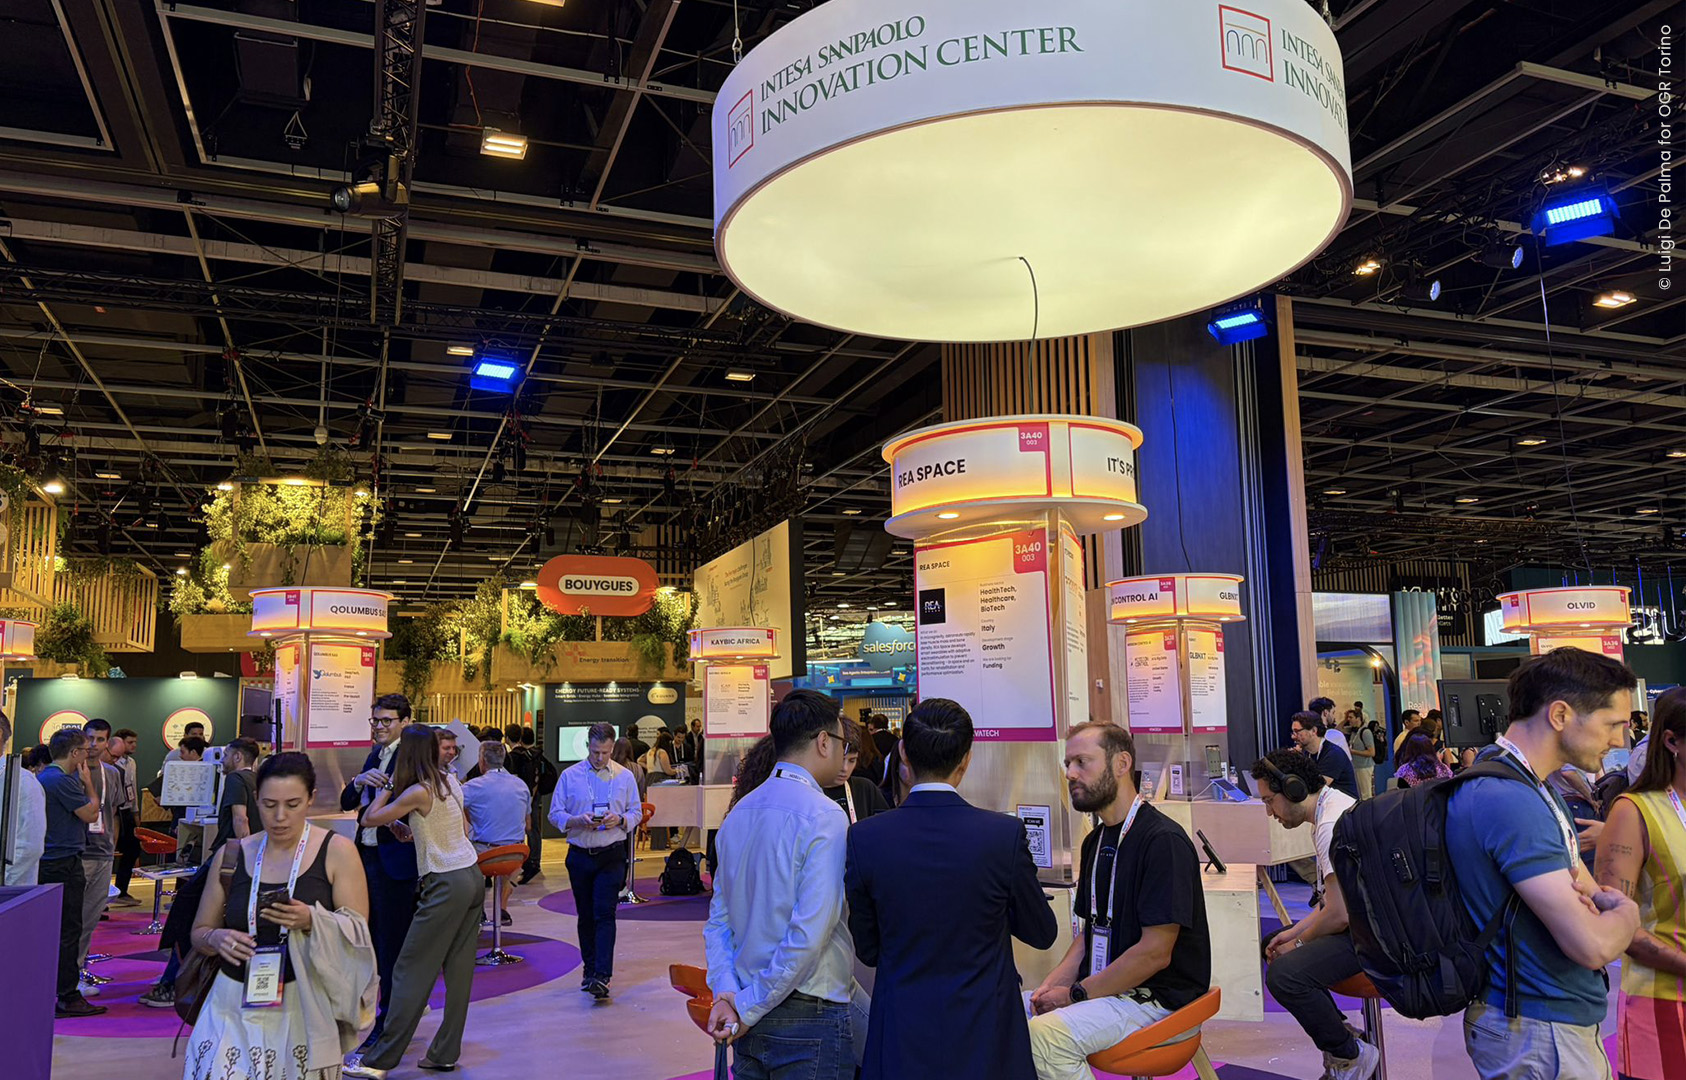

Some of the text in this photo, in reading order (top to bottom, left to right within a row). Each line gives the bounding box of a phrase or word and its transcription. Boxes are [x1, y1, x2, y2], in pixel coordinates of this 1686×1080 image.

[1281, 28, 1324, 76] INTESA
[761, 15, 925, 102] INTESA SANPAOLO
[761, 26, 1085, 135] INNOVATION CENTER
[1020, 431, 1042, 440] 3A40
[1107, 457, 1126, 475] IT'S
[898, 458, 966, 489] REA SPACE
[1015, 541, 1041, 555] 3A40
[1021, 554, 1035, 563] 003
[919, 561, 950, 571] REA SPACE
[565, 579, 633, 591] BOUYGUES
[1114, 593, 1147, 604] CONTROL
[1148, 593, 1158, 601] AI
[330, 605, 378, 616] QOLUMBUS
[980, 604, 1006, 613] BioTech
[1567, 601, 1596, 610] OLVID
[981, 625, 996, 633] Italy
[863, 639, 916, 656] salesforc
[982, 643, 1005, 651] Growth
[973, 729, 1000, 737] VATECH
